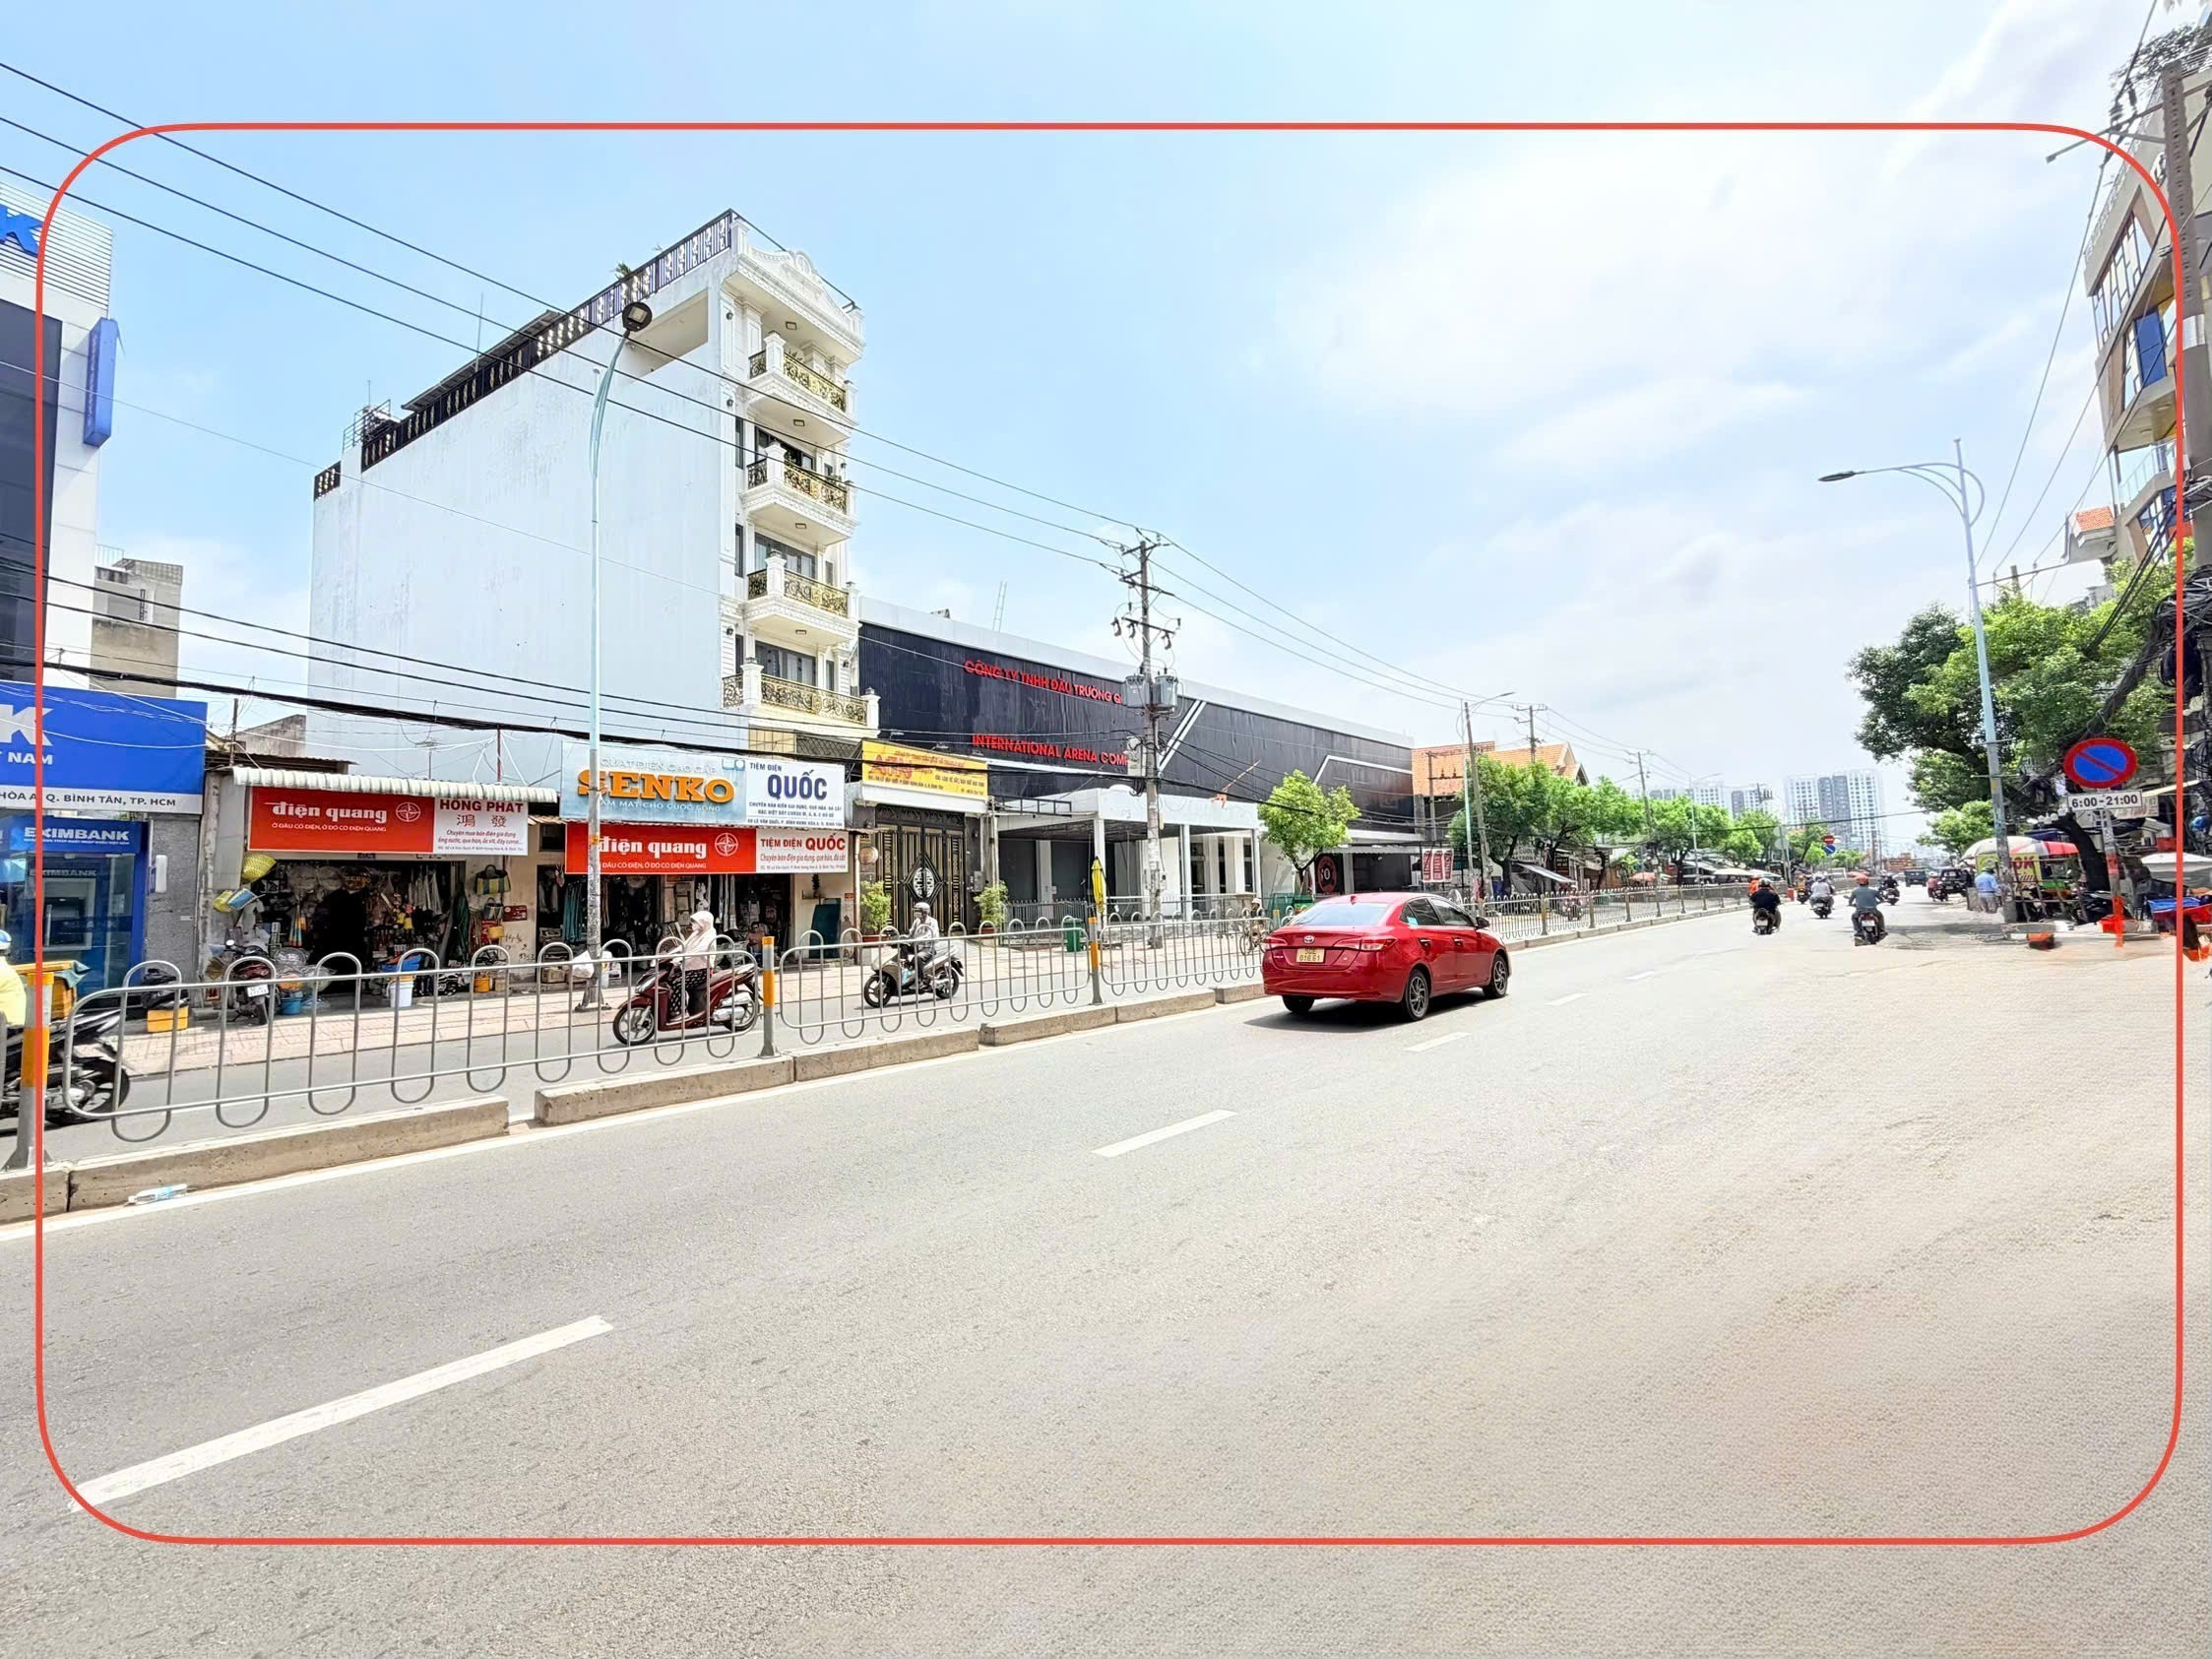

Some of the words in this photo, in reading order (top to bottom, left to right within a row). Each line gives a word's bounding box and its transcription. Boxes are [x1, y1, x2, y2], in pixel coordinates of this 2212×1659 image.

[965, 660, 1002, 678] CÔNG
[1004, 670, 1017, 680] TY
[1020, 672, 1049, 687] TNHH
[972, 734, 1061, 758] INTERNATIONAL
[1063, 746, 1098, 763] ARENA
[8, 752, 53, 765] NAM
[578, 769, 735, 803] SENKO
[768, 769, 828, 800] QUỐC
[64, 793, 95, 802] BÌNH
[130, 797, 147, 805] TP.
[326, 807, 388, 823] quang
[24, 827, 130, 840] EXIMBANK
[761, 837, 781, 850] TIỆM
[784, 838, 802, 851] ĐIỆN
[805, 833, 846, 851] QUỐC
[648, 842, 707, 860] quang
